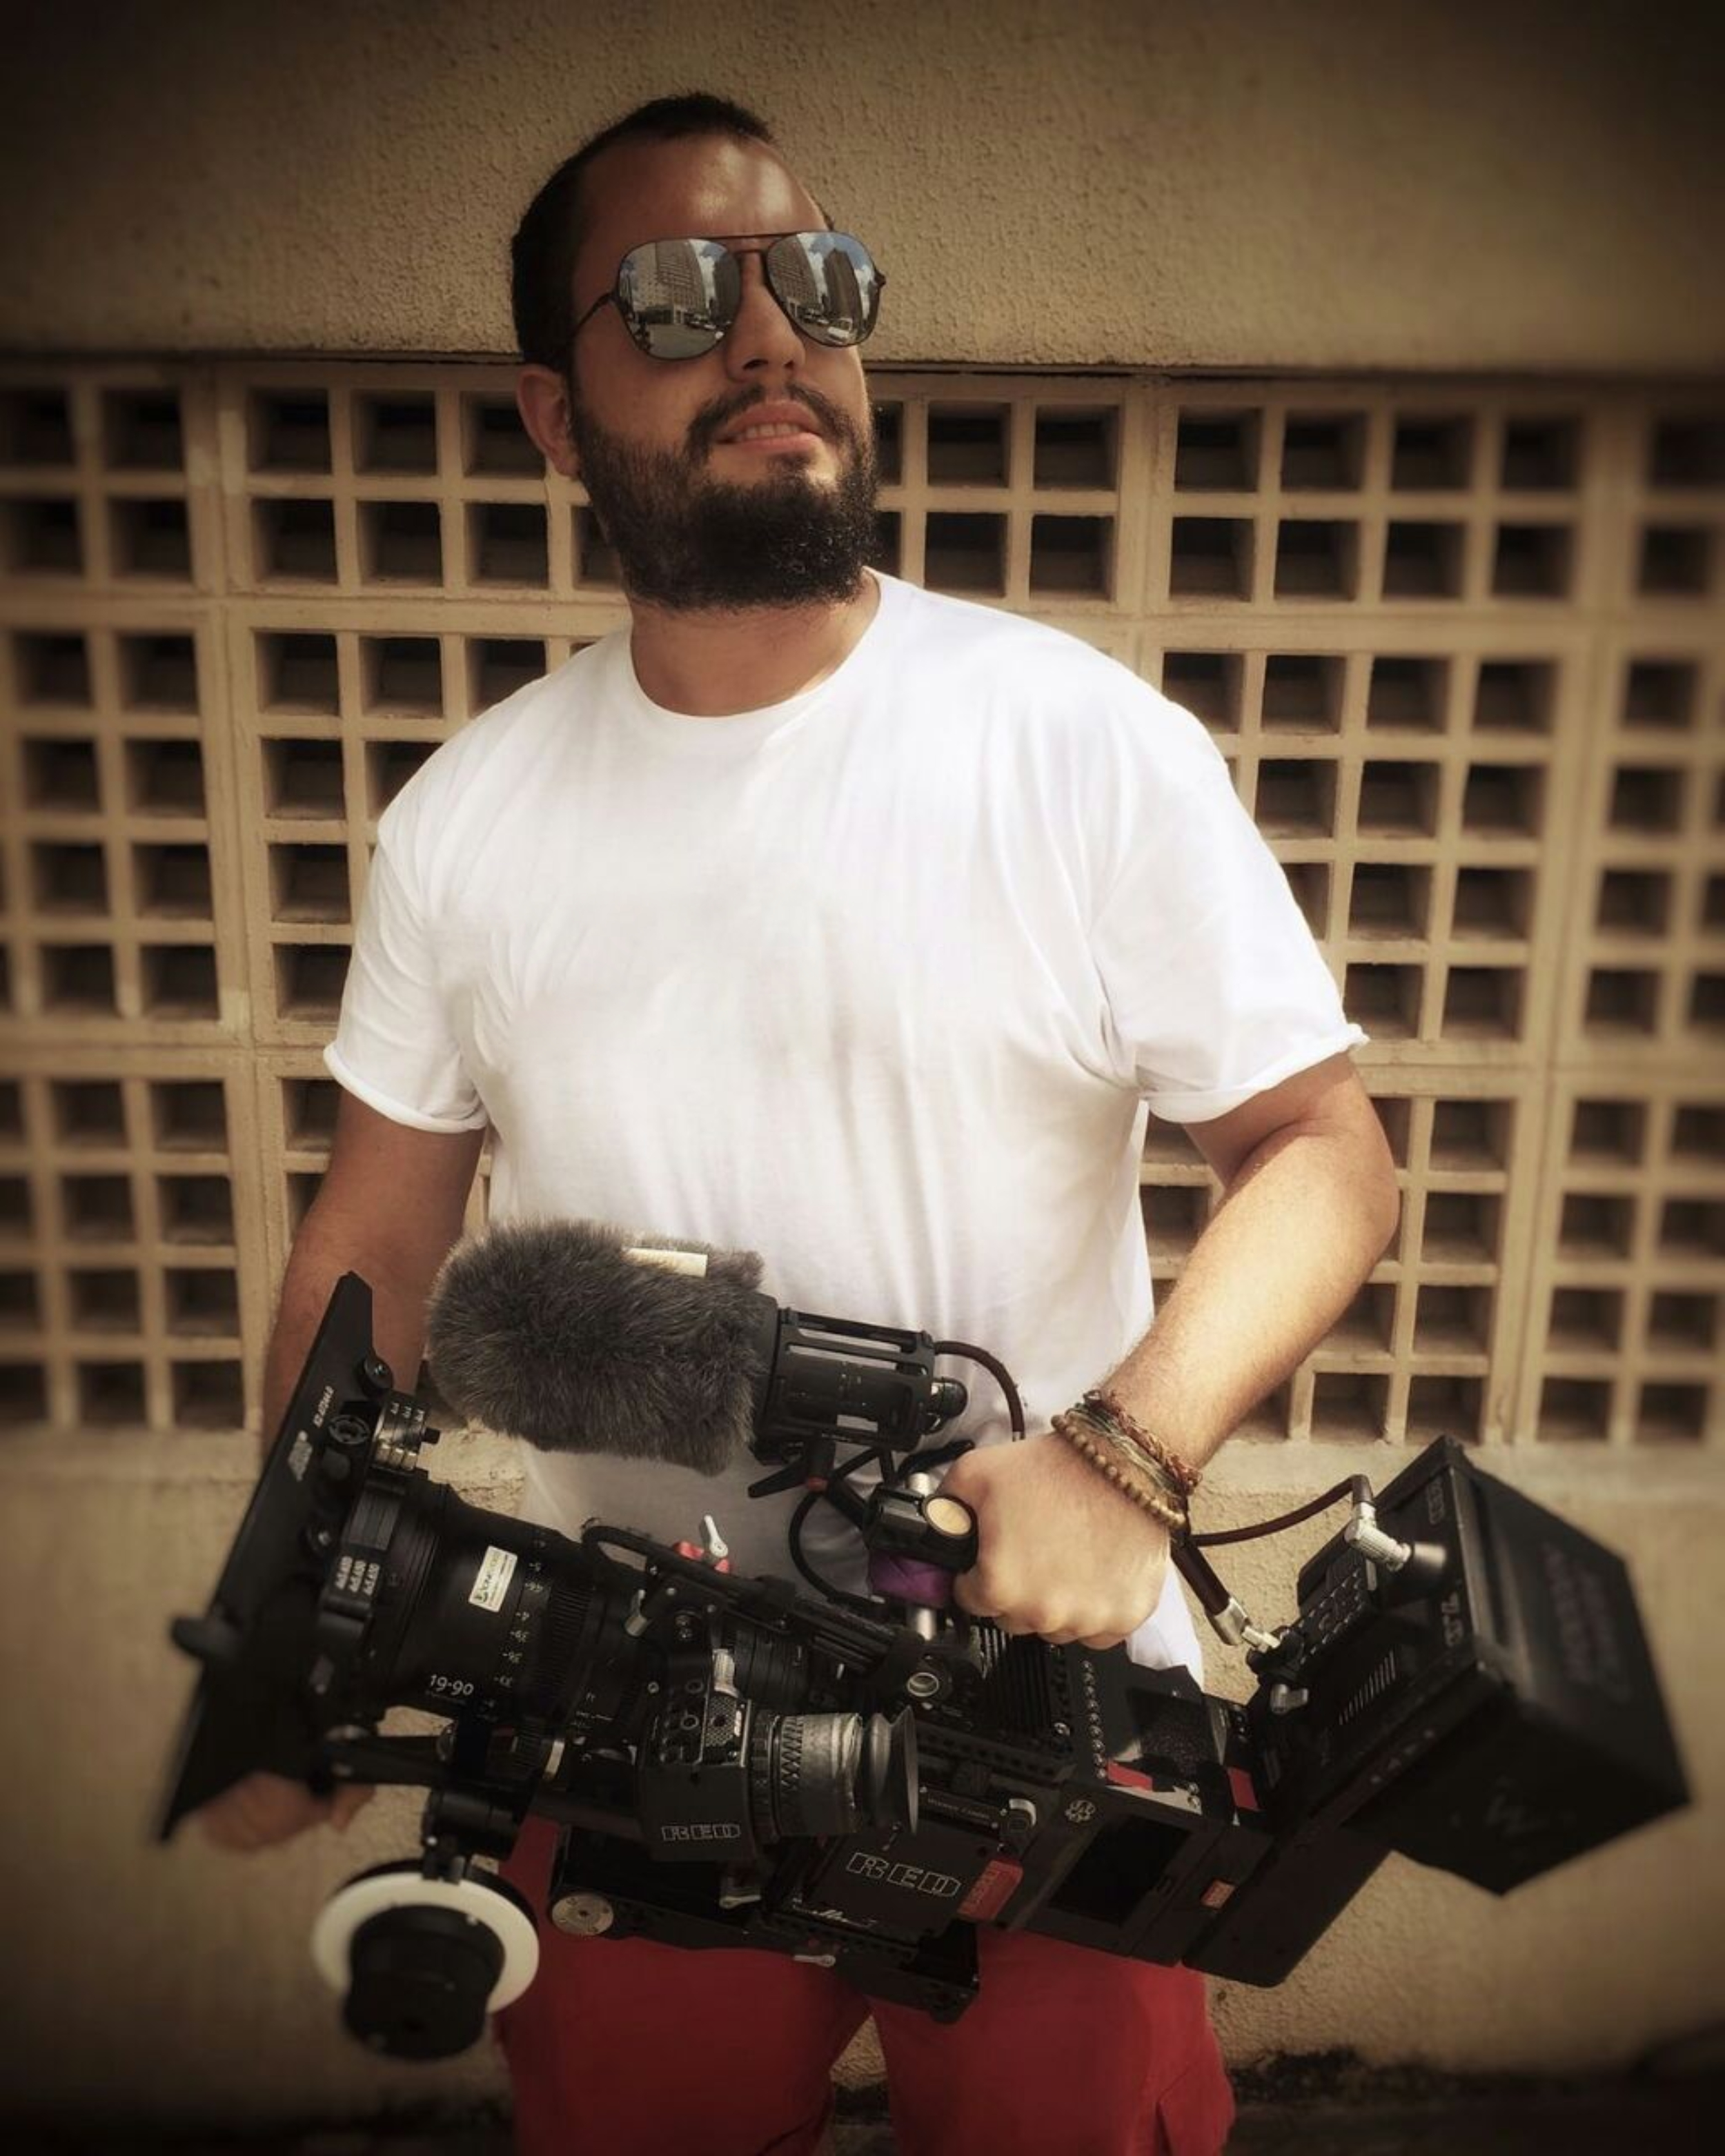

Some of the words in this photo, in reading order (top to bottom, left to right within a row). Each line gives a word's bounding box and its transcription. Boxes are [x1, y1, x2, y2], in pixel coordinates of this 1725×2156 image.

[430, 1673, 474, 1696] 19-90
[661, 1823, 741, 1841] RED
[846, 1852, 962, 1897] RED
